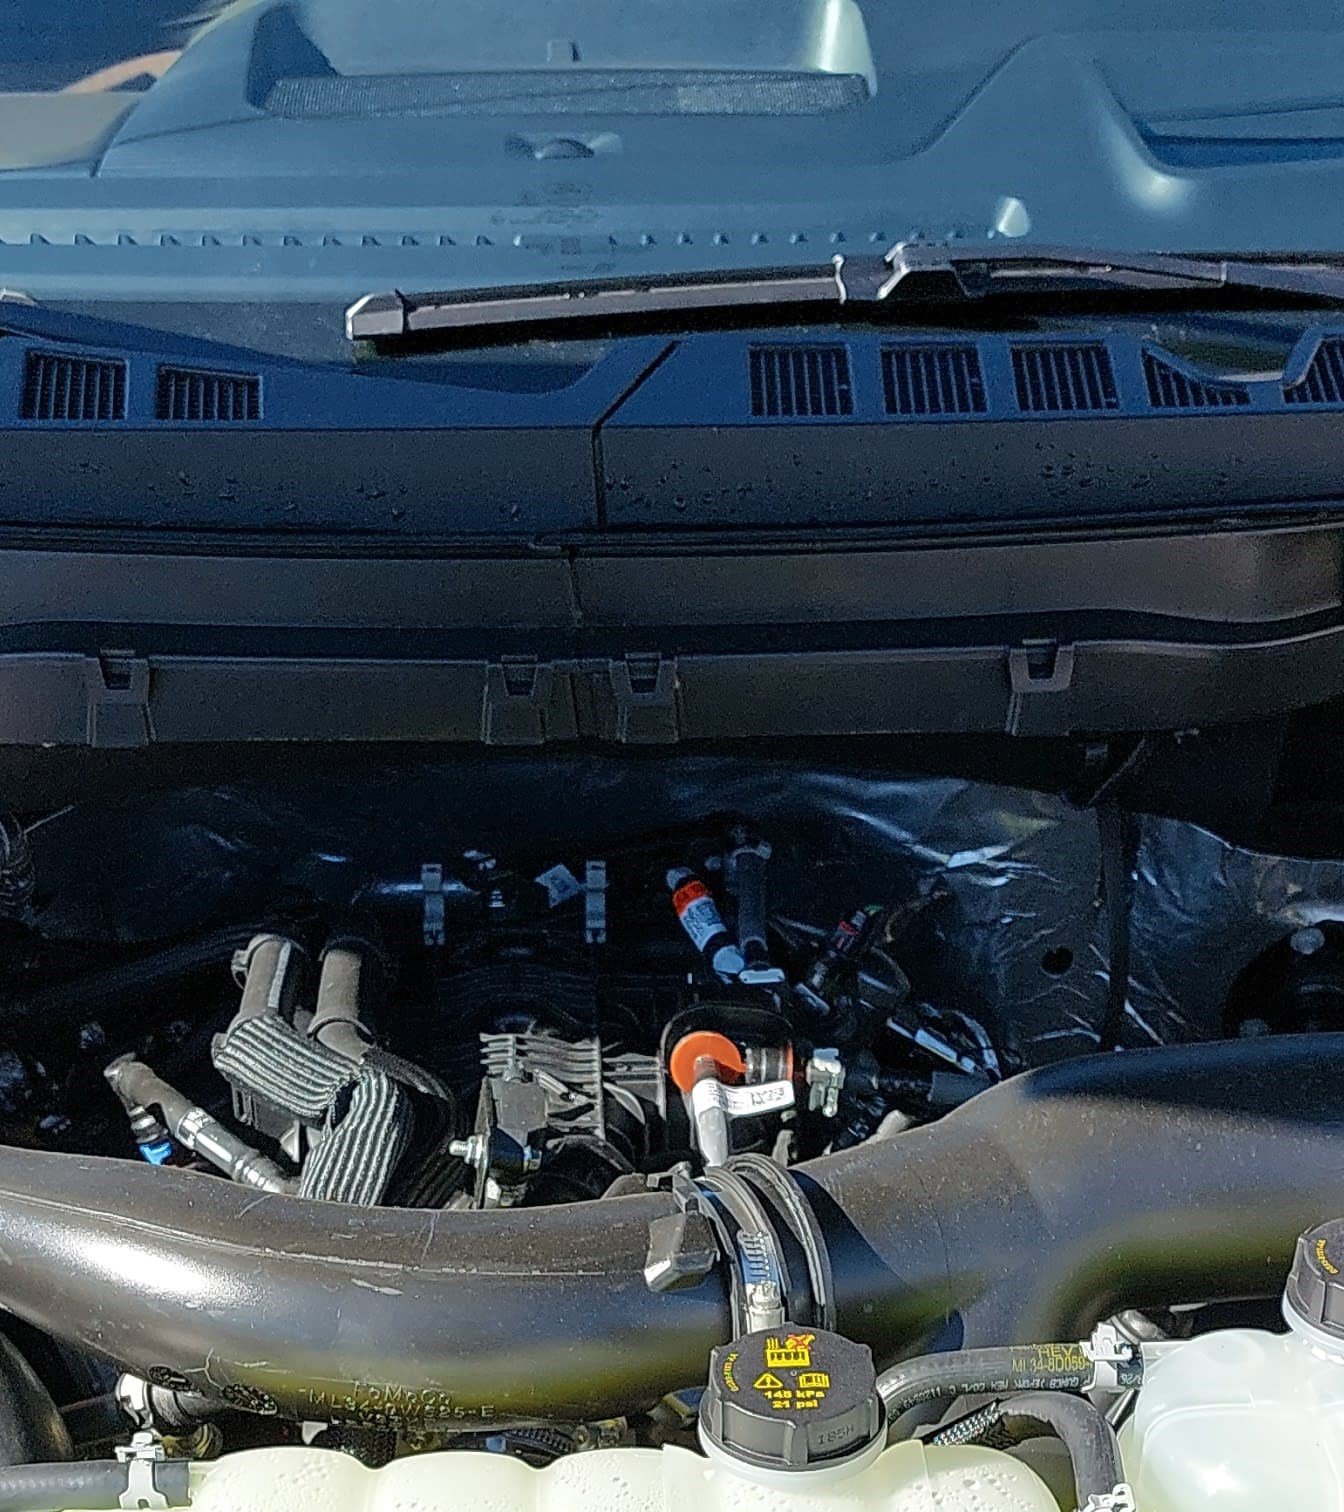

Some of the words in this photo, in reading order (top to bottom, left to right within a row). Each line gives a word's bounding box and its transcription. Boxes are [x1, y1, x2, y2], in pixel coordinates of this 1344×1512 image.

[763, 1389, 793, 1399] 145
[795, 1389, 826, 1399] kPa
[771, 1399, 791, 1409] 21
[795, 1399, 819, 1410] psi
